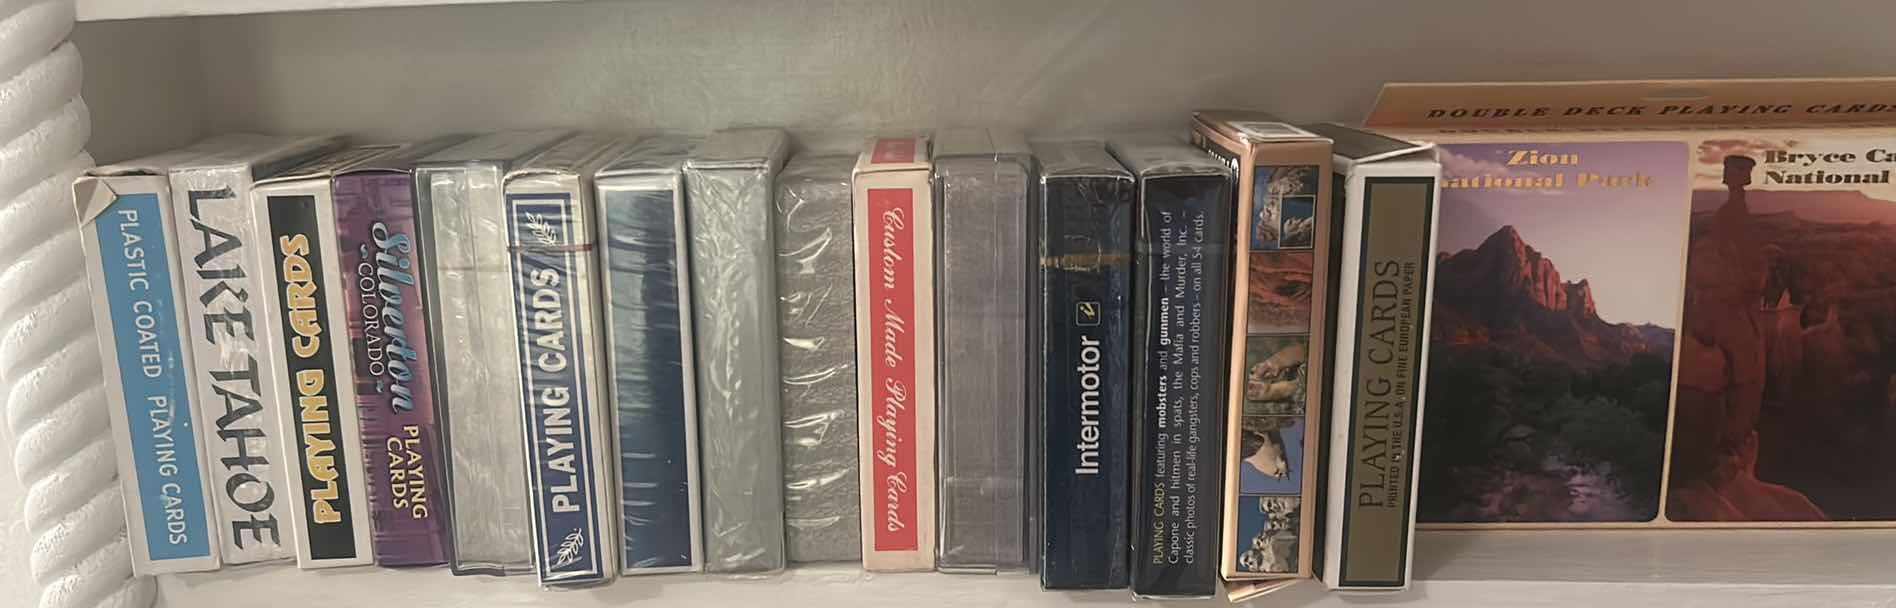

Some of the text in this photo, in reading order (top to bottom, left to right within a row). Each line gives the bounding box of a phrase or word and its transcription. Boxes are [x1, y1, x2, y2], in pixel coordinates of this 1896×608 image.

[1426, 107, 1550, 119] DOUBLE
[1562, 105, 1648, 116] DECK
[1658, 103, 1792, 115] PLAYING
[1507, 150, 1580, 165] Zion
[1764, 149, 1857, 166] Bryce
[1764, 170, 1890, 184] National
[1161, 211, 1172, 223] of
[1193, 211, 1204, 243] cards.
[1161, 228, 1172, 258] world
[1177, 225, 1188, 246] Inc.
[1192, 247, 1202, 259] 54
[1192, 262, 1202, 274] all
[1160, 264, 1170, 280] the
[1176, 253, 1188, 298] Murder,
[1192, 277, 1202, 291] on
[1404, 262, 1415, 295] PAPER
[359, 262, 384, 376] COLORADO
[372, 222, 415, 413] Silverton
[1160, 297, 1171, 345] gunmen
[1175, 306, 1185, 327] and
[1191, 303, 1201, 343] robbers
[1398, 299, 1412, 352] EUROPEAN
[1158, 351, 1168, 370] and
[1174, 334, 1184, 364] Mafia
[1189, 345, 1200, 364] and
[117, 208, 187, 544] PLASTIC COATED PLAYING CARDS
[187, 184, 281, 550] LAKE TAHOE
[280, 233, 341, 524] PLAYING CARDS
[876, 207, 908, 533] Custom Made Playing Cards
[1174, 371, 1184, 389] the
[1190, 367, 1201, 390] cops
[1397, 355, 1408, 378] FINE
[530, 267, 580, 513] PLAYING CARDS
[1358, 260, 1400, 509] PLAYING CARDS
[1396, 382, 1406, 395] ON
[1075, 335, 1100, 475] Intermotor
[1157, 376, 1168, 428] mobsters
[1173, 396, 1185, 428] spats,
[1188, 393, 1200, 443] gangsters,
[1172, 434, 1182, 444] in
[1392, 431, 1402, 449] THE
[1156, 433, 1169, 478] featuring
[1171, 451, 1181, 489] hitmen
[1187, 446, 1198, 480] real-life
[1391, 453, 1401, 463] IN
[385, 436, 409, 509] CARDS
[403, 425, 428, 519] PLAYING
[1186, 482, 1196, 493] of
[1387, 466, 1400, 508] PRINTED
[1154, 482, 1165, 517] CARDS
[1170, 496, 1180, 516] and
[1186, 496, 1197, 528] photos
[1154, 521, 1165, 564] PLAYING
[1169, 522, 1181, 564] Capone
[1184, 531, 1194, 564] classic
